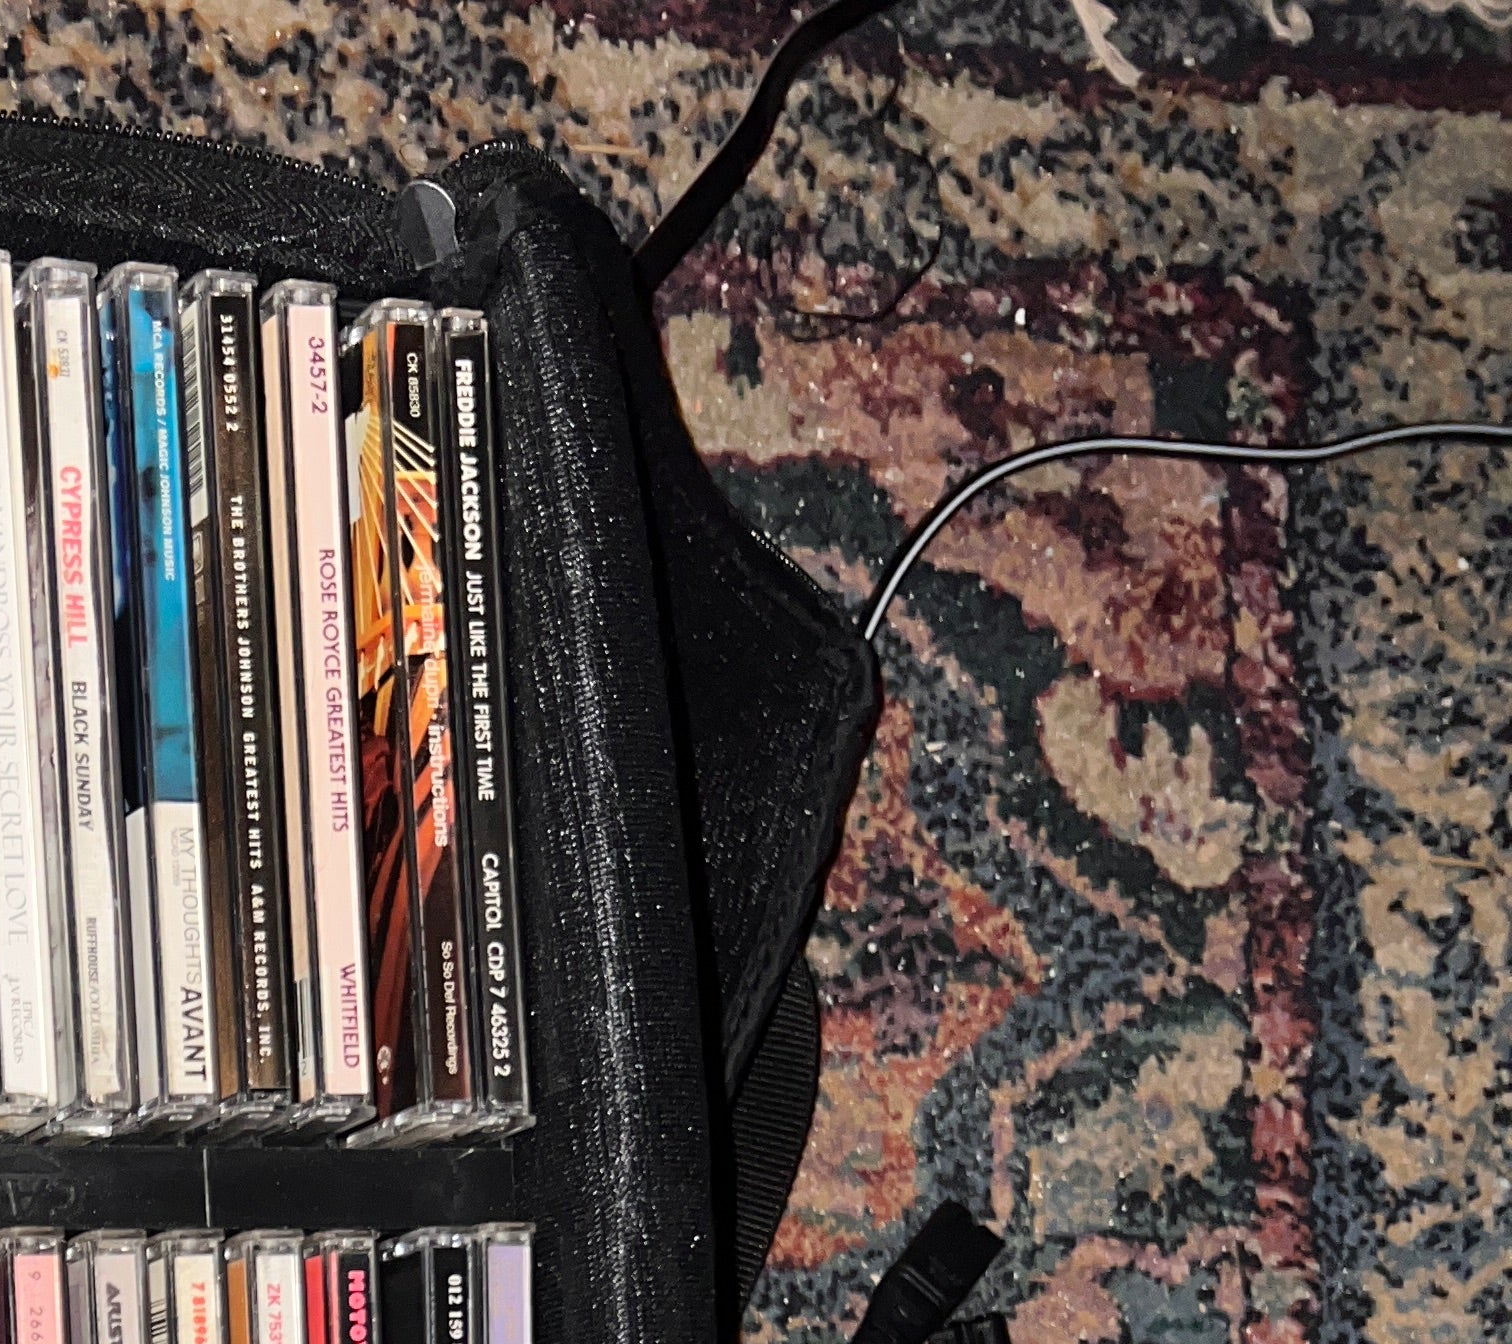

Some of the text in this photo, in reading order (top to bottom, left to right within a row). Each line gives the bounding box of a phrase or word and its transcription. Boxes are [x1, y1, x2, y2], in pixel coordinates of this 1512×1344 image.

[308, 335, 329, 413] 3457-2
[455, 358, 496, 801] FREDDIE JACKSON JUST LIKE THE FIRST TIME
[60, 465, 94, 830] CYPRESS HILL BLACK SUNDAY
[319, 548, 350, 832] ROSE ROYCE GREATEST HITS
[230, 494, 273, 1063] THE BROTHERS JOHNSON GREATEST HITS A&M RECORDS, INC.
[0, 872, 30, 945] LOVE
[340, 962, 361, 1068] WHITFIELD
[448, 1273, 464, 1305] 012
[448, 1310, 464, 1340] 159
